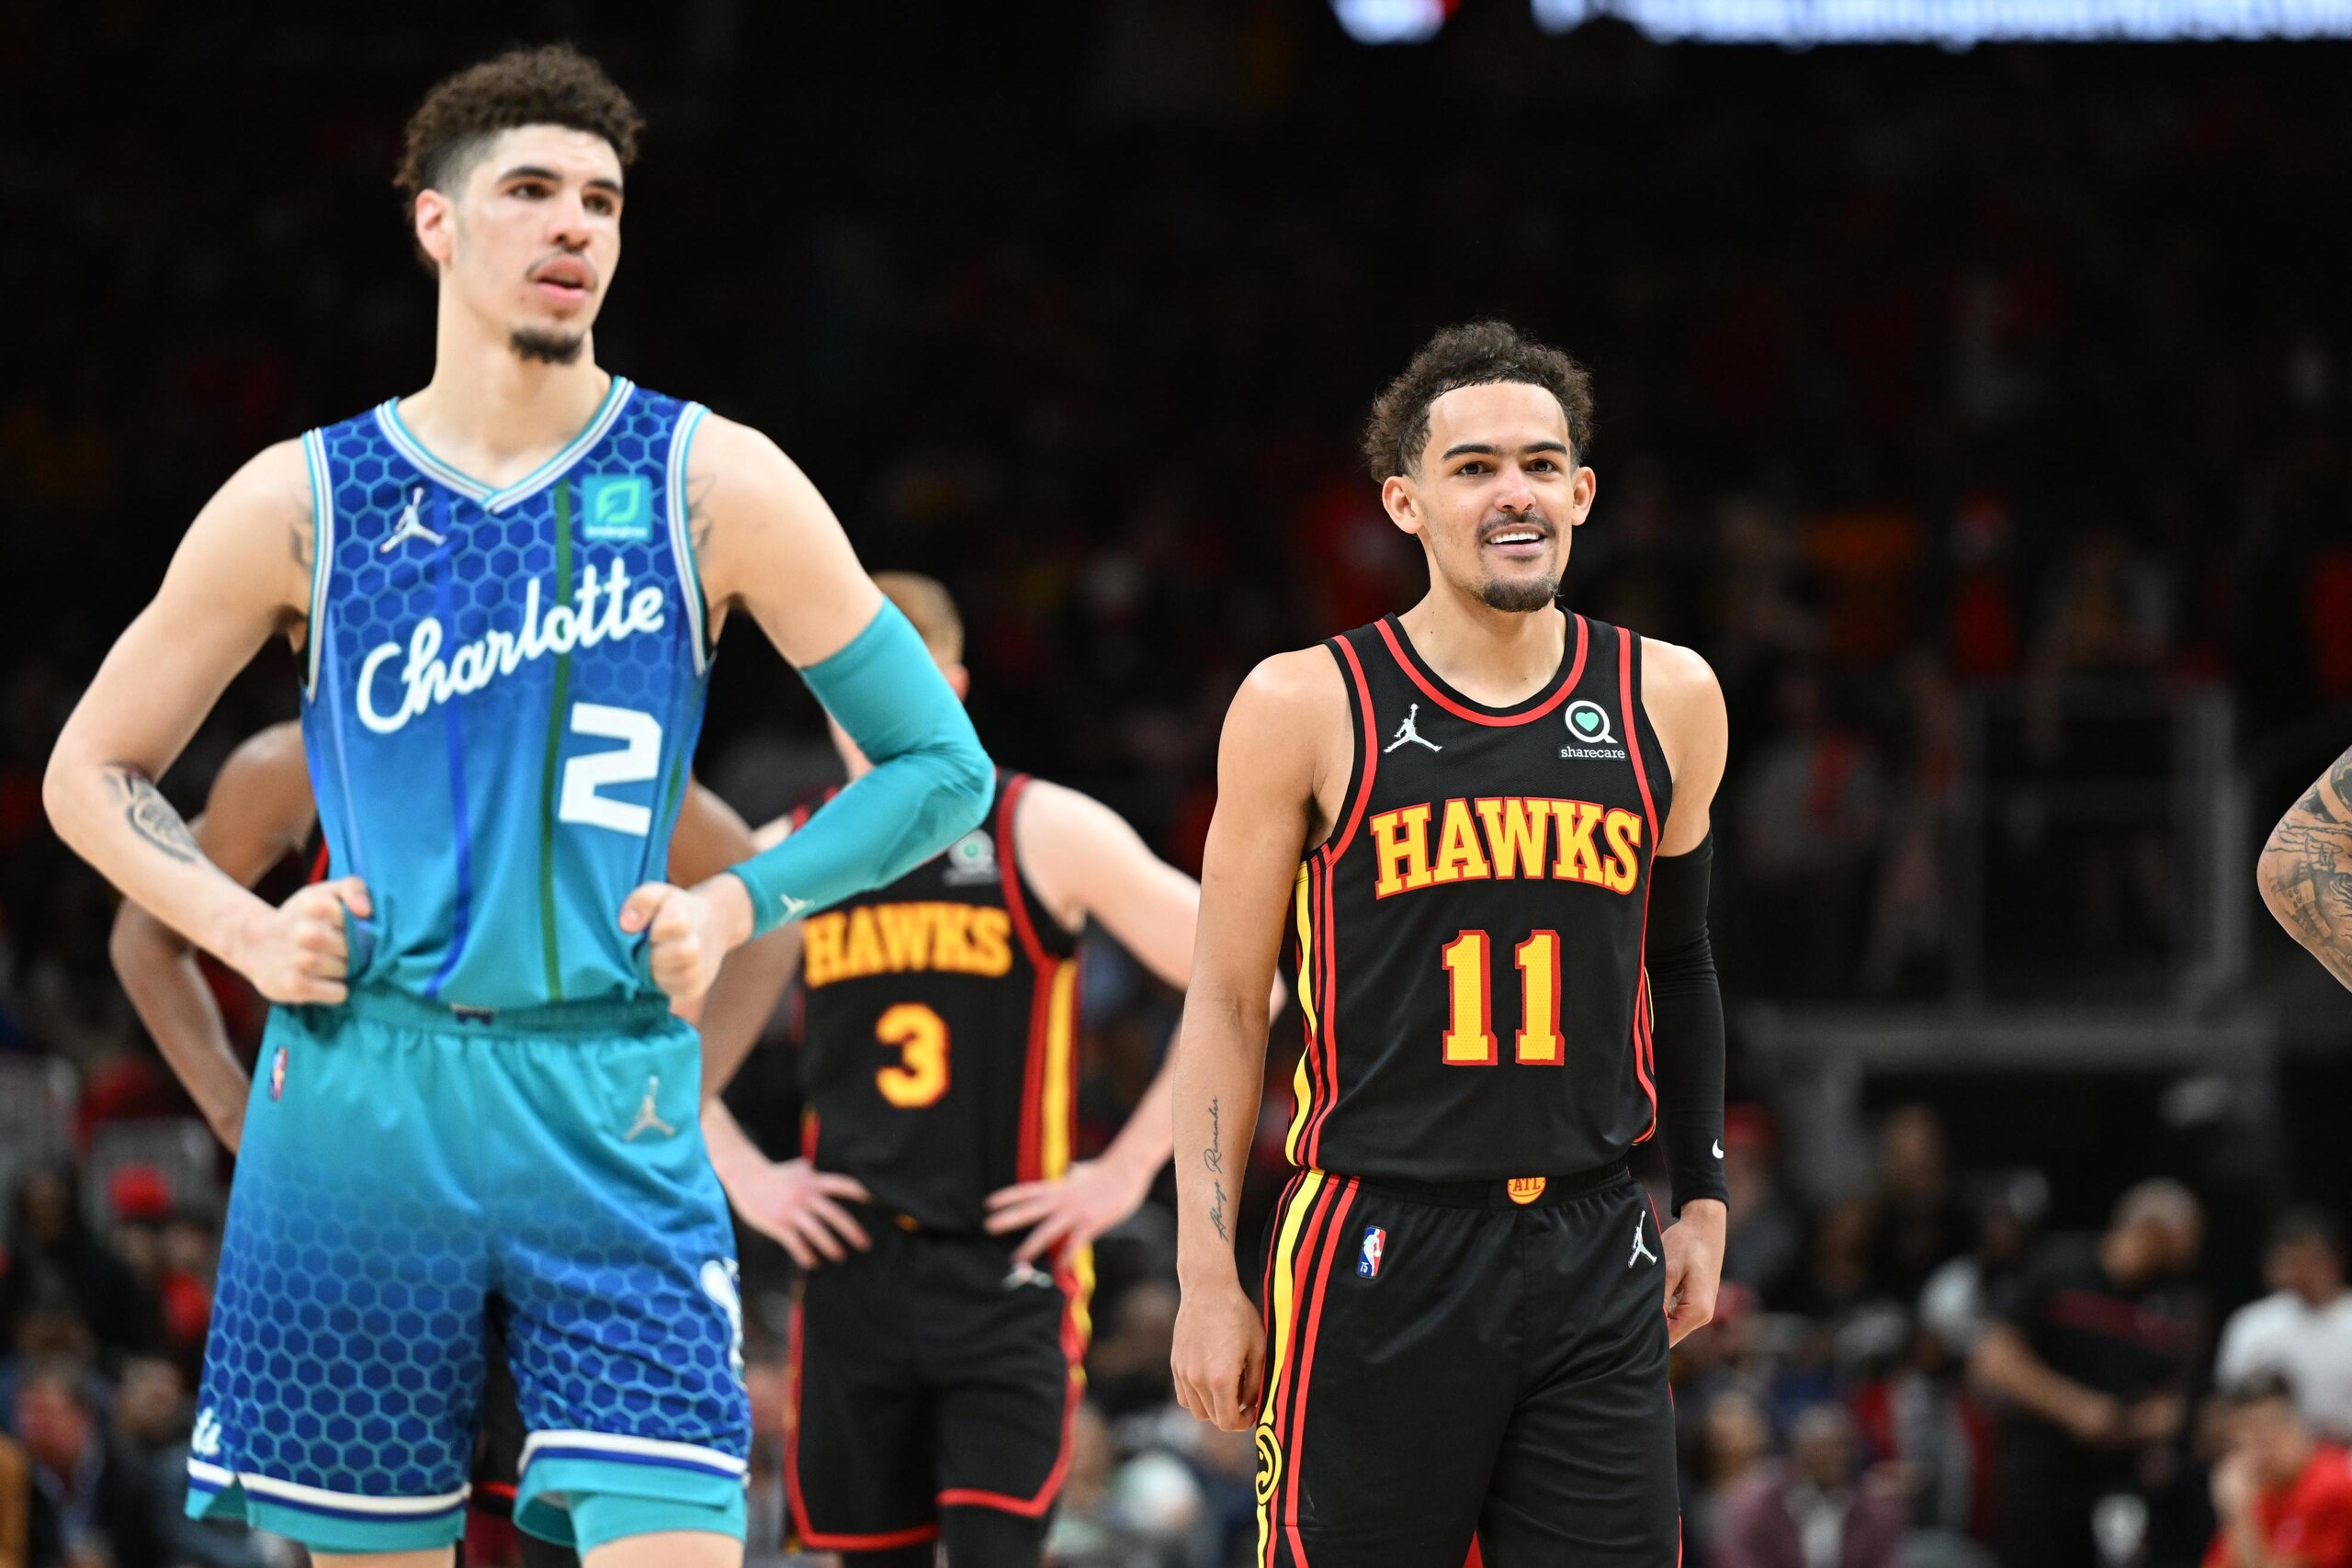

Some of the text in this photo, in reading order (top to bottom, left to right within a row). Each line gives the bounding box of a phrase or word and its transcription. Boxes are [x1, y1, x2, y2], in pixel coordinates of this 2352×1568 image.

[356, 556, 664, 734] Charlotte
[559, 702, 662, 837] 2
[1561, 746, 1625, 759] sharecare
[1369, 796, 1642, 900] HAWKS
[804, 902, 1012, 988] HAWKS
[1442, 929, 1565, 1066] 11
[875, 1002, 951, 1109] 3
[1204, 1095, 1222, 1174] Remember
[1360, 1261, 1369, 1273] 75
